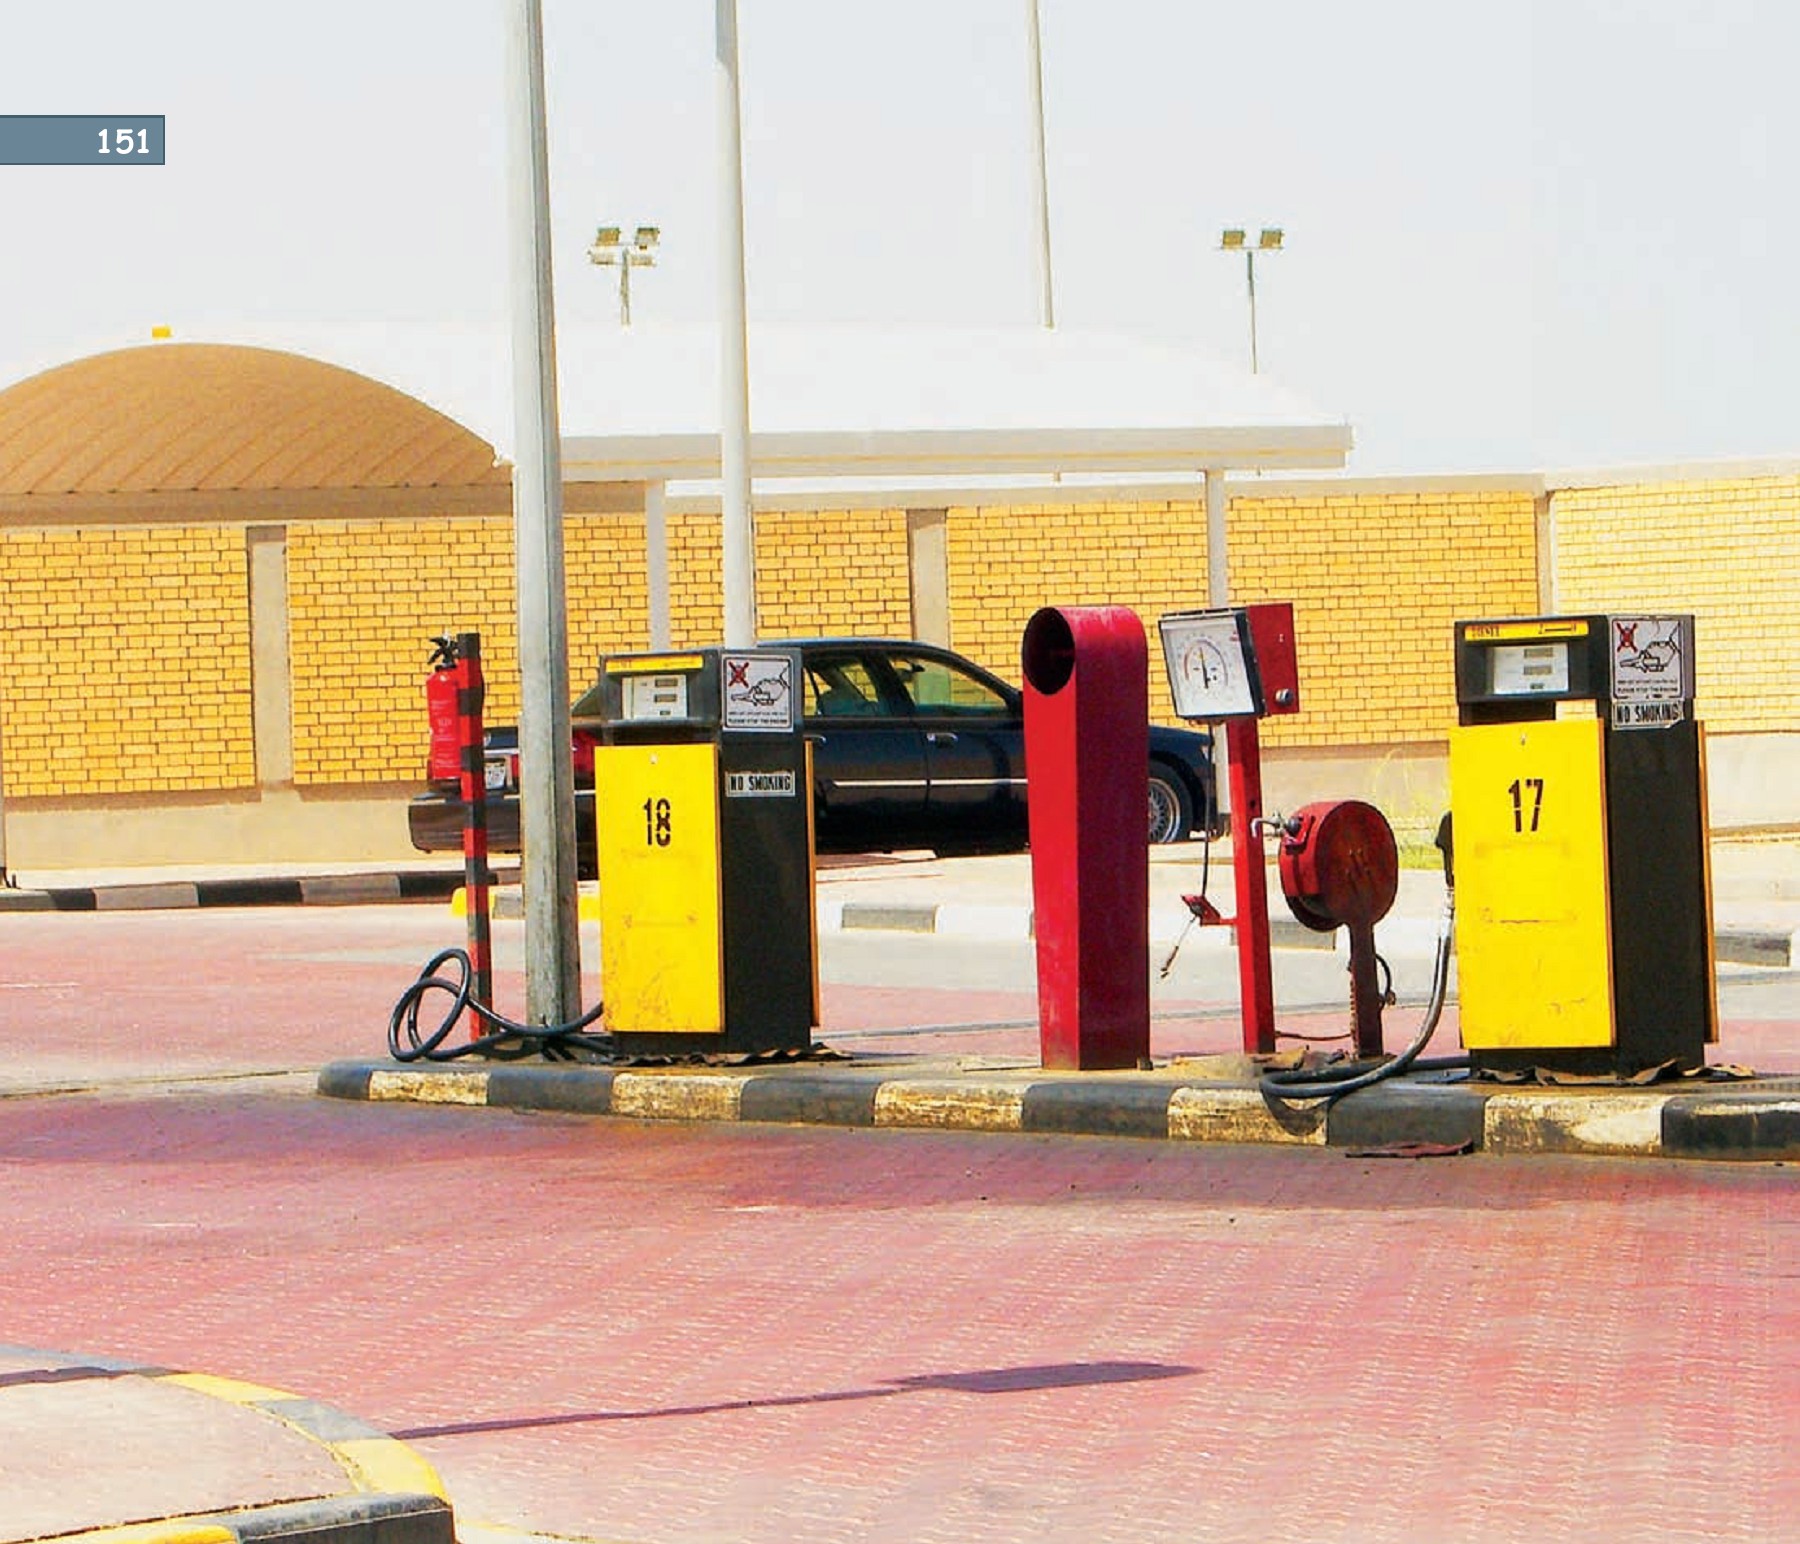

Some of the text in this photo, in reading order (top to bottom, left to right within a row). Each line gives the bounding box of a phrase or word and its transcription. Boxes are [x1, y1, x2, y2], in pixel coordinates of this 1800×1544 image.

[1616, 702, 1679, 723] NO SMOKING
[730, 775, 791, 791] NO SMOKING
[643, 797, 671, 847] 18
[1507, 778, 1544, 833] 17
